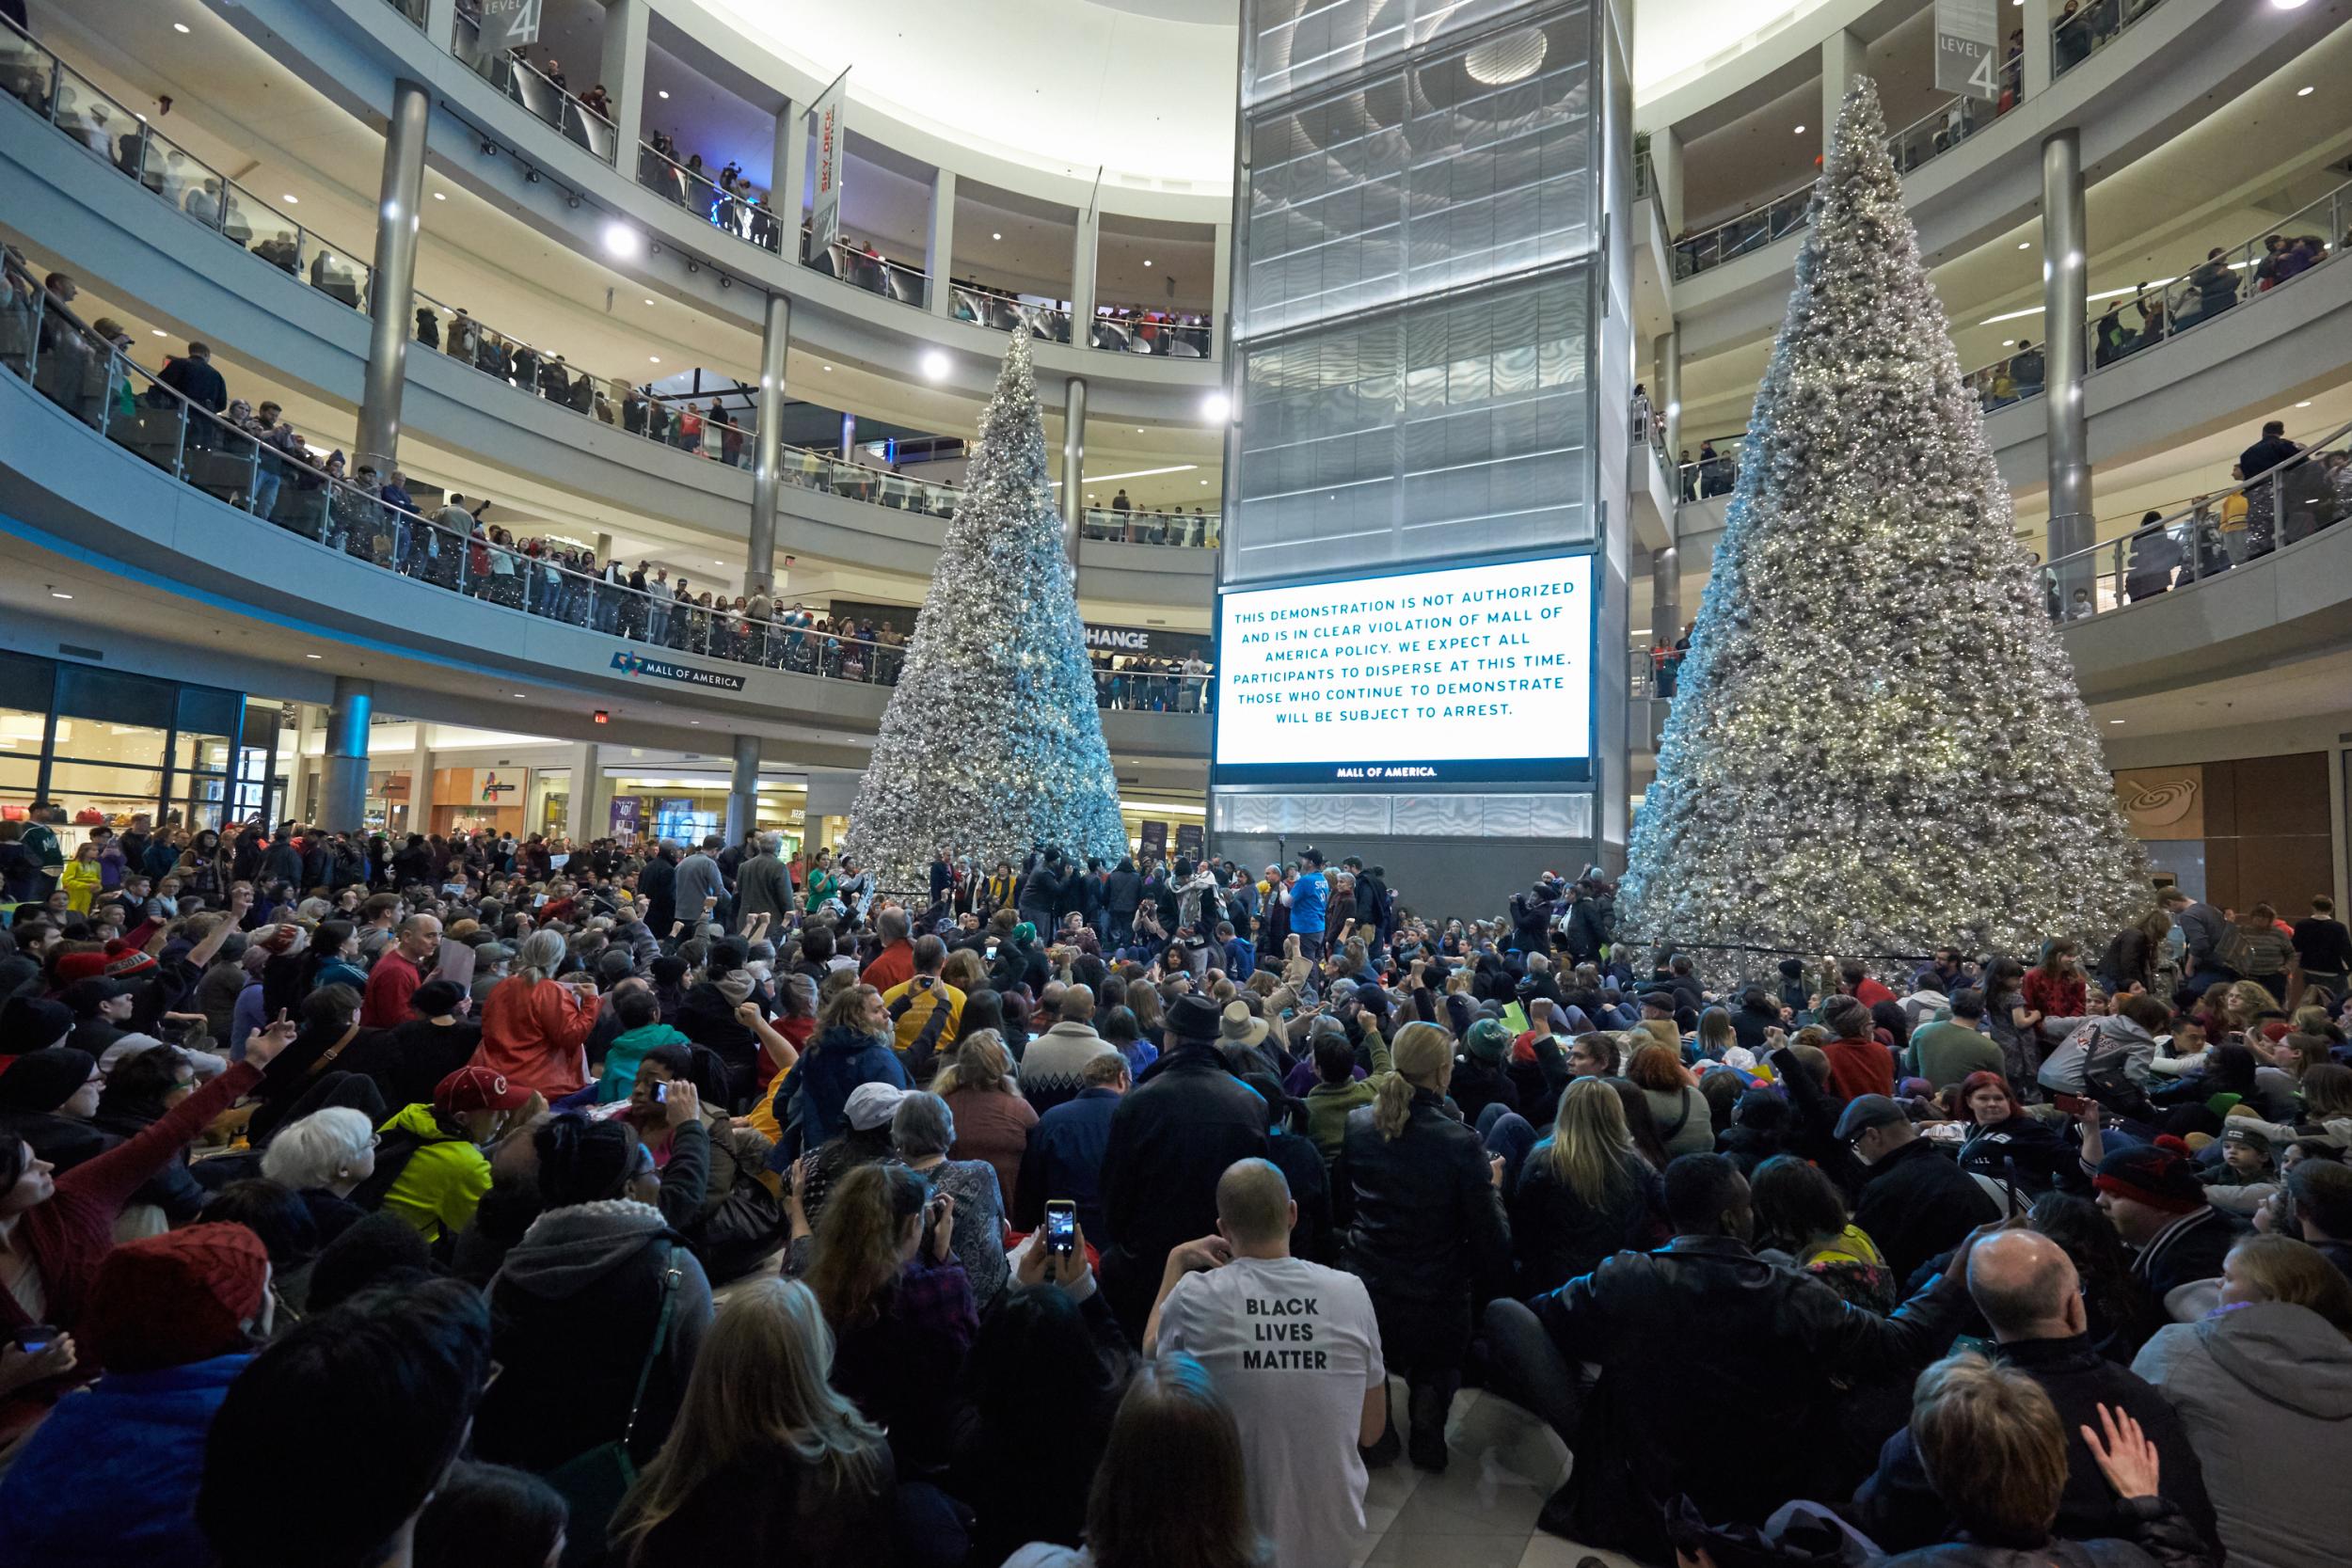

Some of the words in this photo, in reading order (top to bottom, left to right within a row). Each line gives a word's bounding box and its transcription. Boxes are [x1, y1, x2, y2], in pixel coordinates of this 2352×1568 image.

[485, 0, 521, 15] LEVEL
[506, 0, 535, 42] 4
[1941, 37, 1980, 58] LEVEL
[1967, 48, 1998, 99] 4
[823, 109, 832, 152] DECK
[820, 160, 829, 195] SKY
[822, 204, 836, 243] 4
[1235, 612, 1264, 624] THIS
[1271, 600, 1394, 621] DEMONSTRATION
[1402, 598, 1416, 609] IS
[1423, 594, 1454, 607] NOT
[1462, 582, 1574, 603] AUTHORIZED
[1084, 628, 1149, 649] HANGE
[1242, 632, 1269, 643] AND
[1276, 631, 1288, 641] IS
[1295, 629, 1308, 639] IN
[1314, 625, 1360, 638] CLEAR
[1369, 617, 1452, 633] VIOLATION
[1459, 613, 1480, 626] OF
[1487, 610, 1533, 624] MALL
[1540, 607, 1563, 619] OF
[1265, 648, 1328, 662] AMERICA
[1336, 643, 1391, 657] POLICY.
[1399, 641, 1421, 652] WE
[1428, 636, 1490, 650] EXPECT
[1499, 633, 1530, 645] ALL
[646, 663, 673, 676] MALL
[675, 669, 690, 679] OF
[692, 672, 738, 688] AMERICA
[1233, 669, 1334, 684] PARTICIPANTS
[1342, 667, 1359, 678] TO
[1366, 662, 1442, 677] DISPERSE
[1450, 660, 1469, 672] AT
[1477, 657, 1516, 670] THIS
[1524, 654, 1571, 667] TIME.
[1238, 693, 1282, 705] THOSE
[1289, 690, 1320, 702] WHO
[1327, 686, 1403, 701] CONTINUE
[1411, 685, 1430, 695] TO
[1438, 677, 1564, 694] DEMONSTRATE
[1277, 713, 1309, 723] WILL
[1315, 711, 1332, 721] BE
[1340, 708, 1409, 721] SUBJECT
[1417, 707, 1436, 718] TO
[1443, 704, 1512, 717] ARREST.
[1337, 768, 1364, 777] MALL
[1367, 767, 1383, 777] OF
[1246, 1298, 1319, 1316] BLACK
[1255, 1323, 1313, 1342] LIVES
[1243, 1350, 1327, 1370] MATTER
